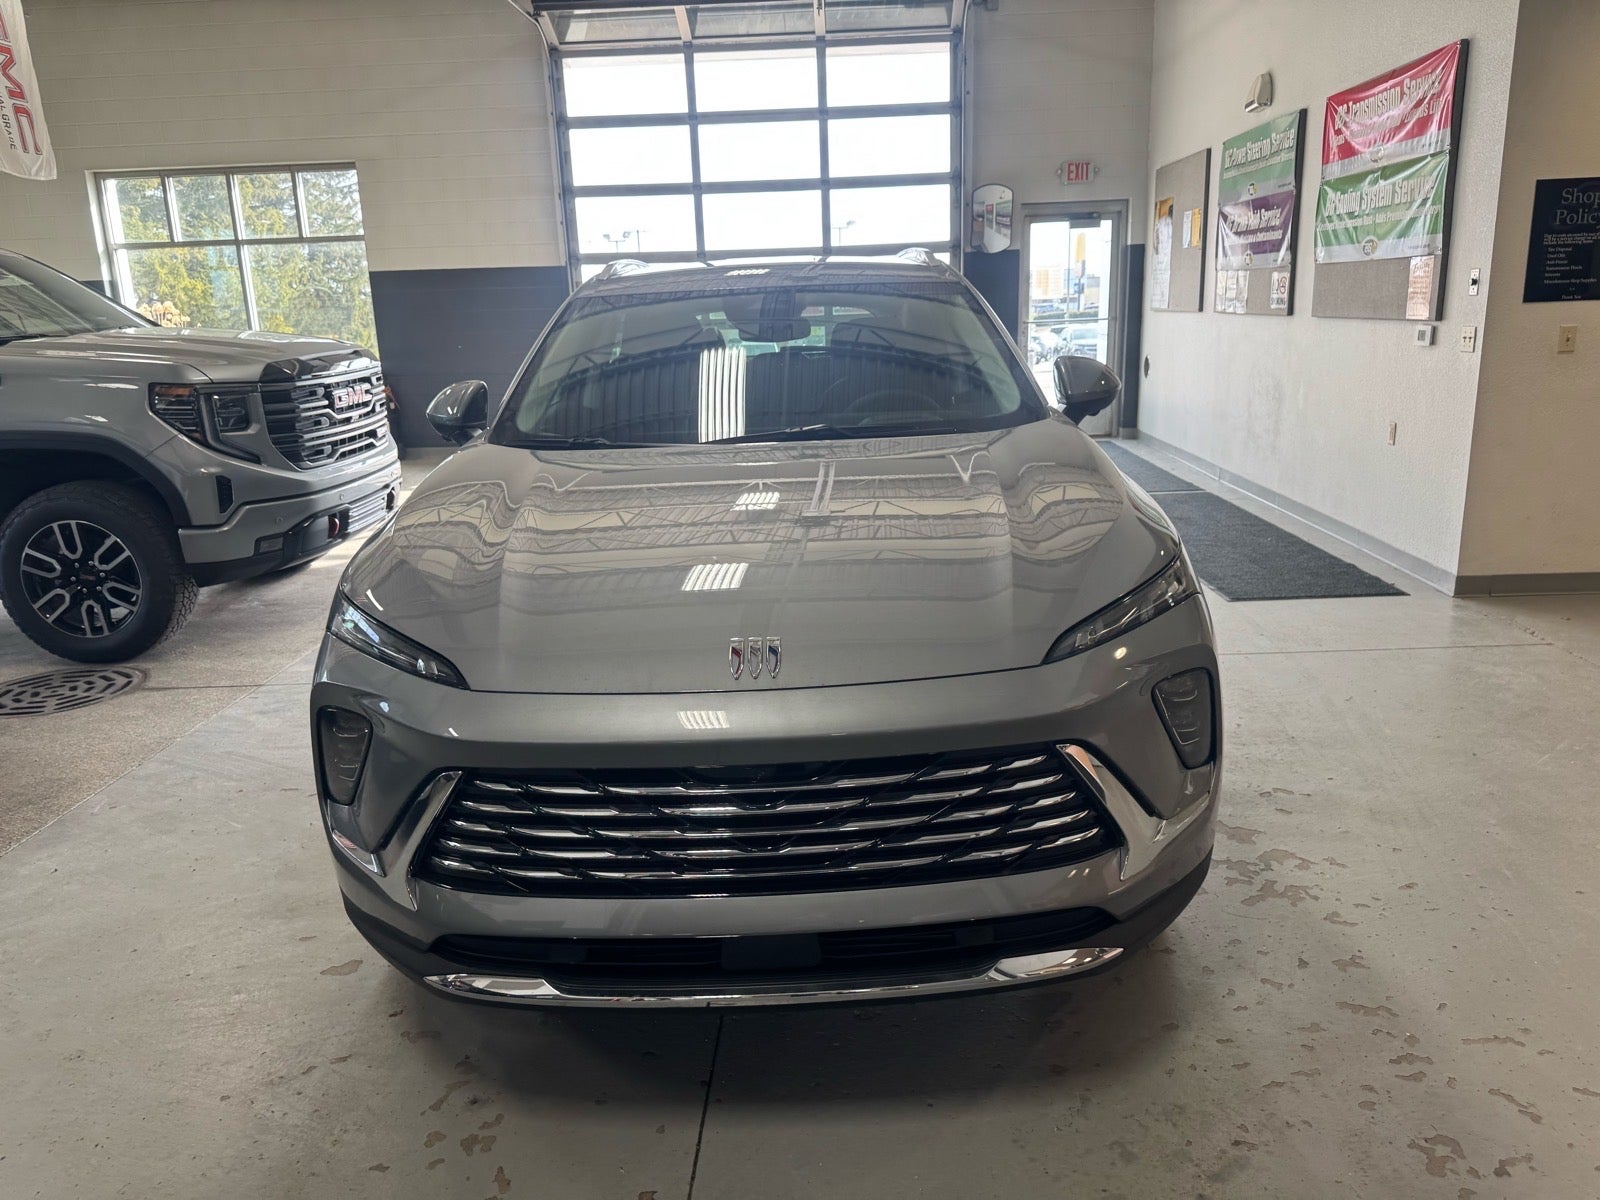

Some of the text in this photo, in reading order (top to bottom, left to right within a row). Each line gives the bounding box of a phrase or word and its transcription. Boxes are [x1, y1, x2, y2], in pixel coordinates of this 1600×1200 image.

[1348, 85, 1401, 123] Transmission
[1403, 68, 1442, 103] Service
[1246, 136, 1271, 162] Steering
[1271, 127, 1295, 154] Service
[1067, 162, 1091, 181] EXIT
[1361, 183, 1393, 215] System
[1395, 174, 1436, 205] Service
[1561, 187, 1600, 208] Shop
[1260, 206, 1281, 228] Service
[1554, 208, 1600, 229] Polic
[332, 383, 373, 409] GMC
